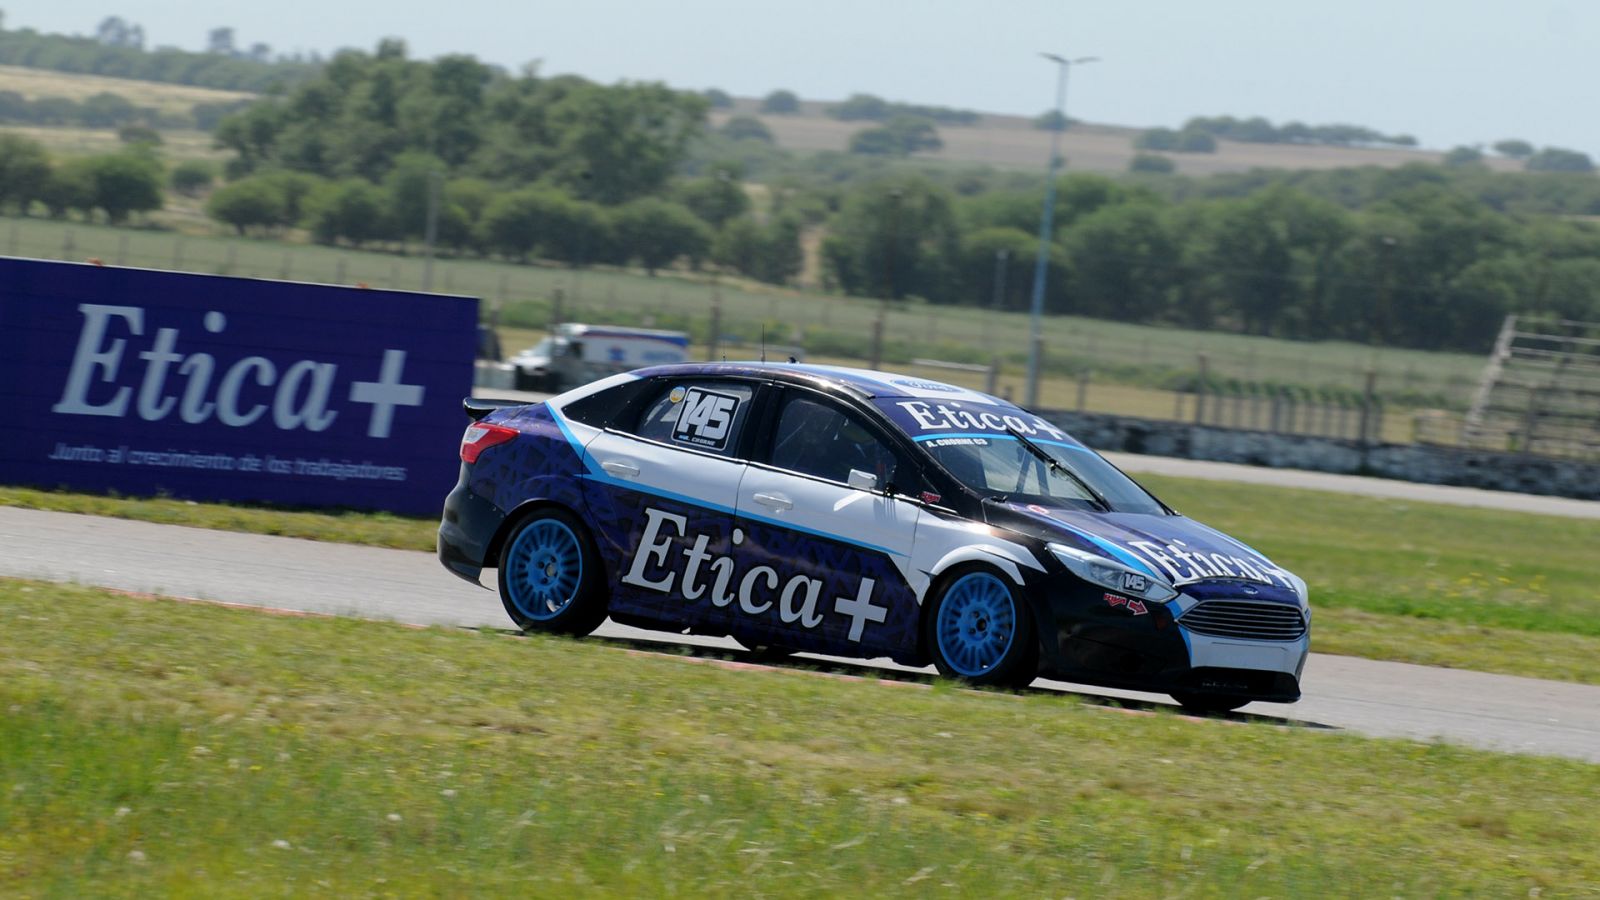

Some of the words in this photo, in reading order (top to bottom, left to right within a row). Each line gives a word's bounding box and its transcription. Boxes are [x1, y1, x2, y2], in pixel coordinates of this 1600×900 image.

[53, 303, 425, 438] Etica+
[677, 391, 736, 439] 145
[48, 442, 103, 462] Junto
[105, 445, 126, 464] al
[127, 448, 236, 471] crecimiento
[237, 453, 263, 472] de
[265, 454, 293, 474] los
[293, 457, 407, 481] trabajadores
[622, 508, 888, 642] Etica+
[1124, 573, 1145, 591] 145
